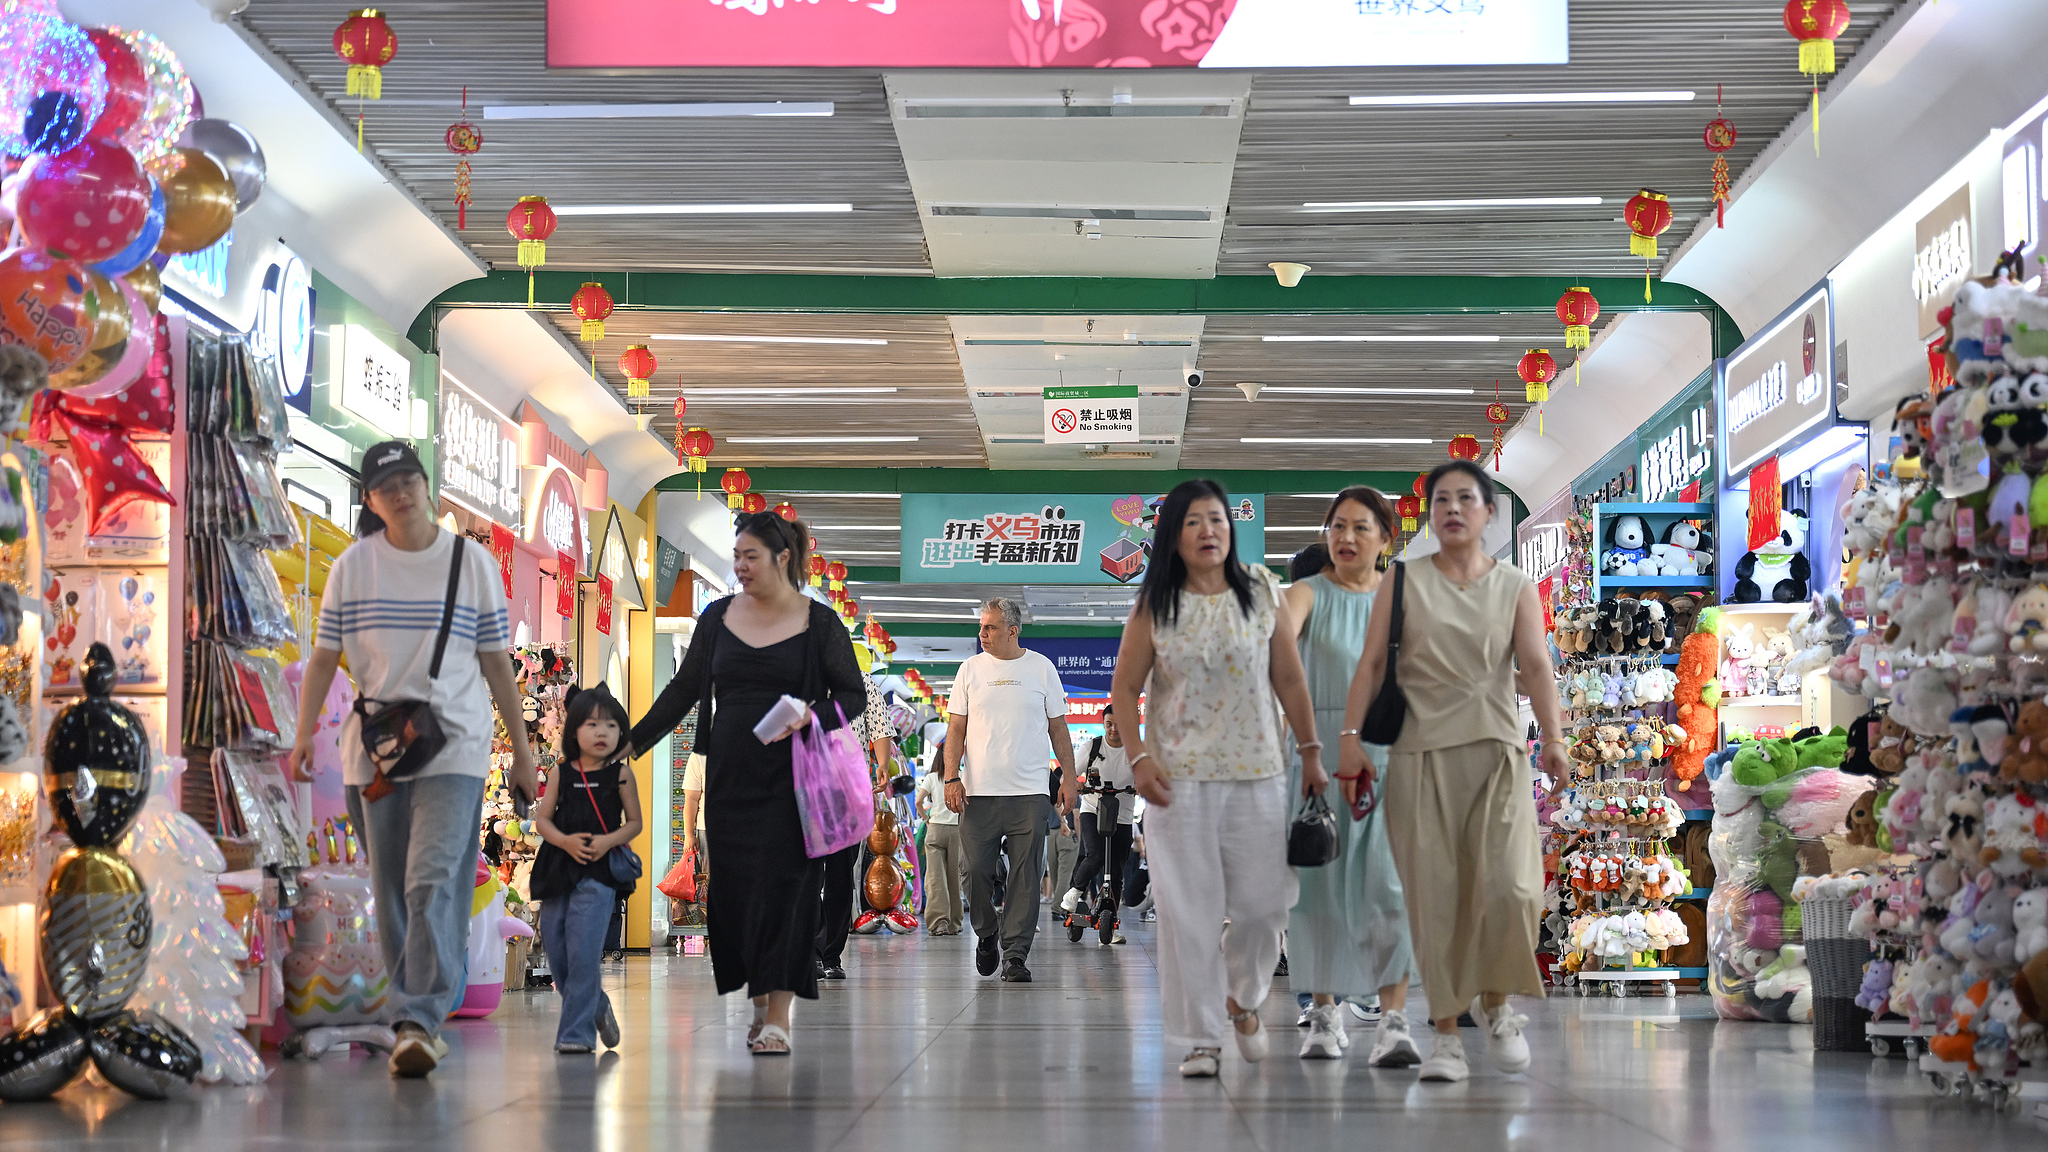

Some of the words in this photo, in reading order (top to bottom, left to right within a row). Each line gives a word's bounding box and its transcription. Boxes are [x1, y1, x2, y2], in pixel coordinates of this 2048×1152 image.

[16, 289, 88, 356] Happy
[1080, 408, 1132, 421] 禁止吸烟
[1080, 423, 1092, 431] No
[1094, 423, 1132, 432] Smoking
[1116, 501, 1140, 512] LOVE
[1119, 508, 1140, 517] YIWU
[945, 515, 1082, 542] 打卡义乌市场
[922, 541, 1079, 567] 逛出丰盈新知
